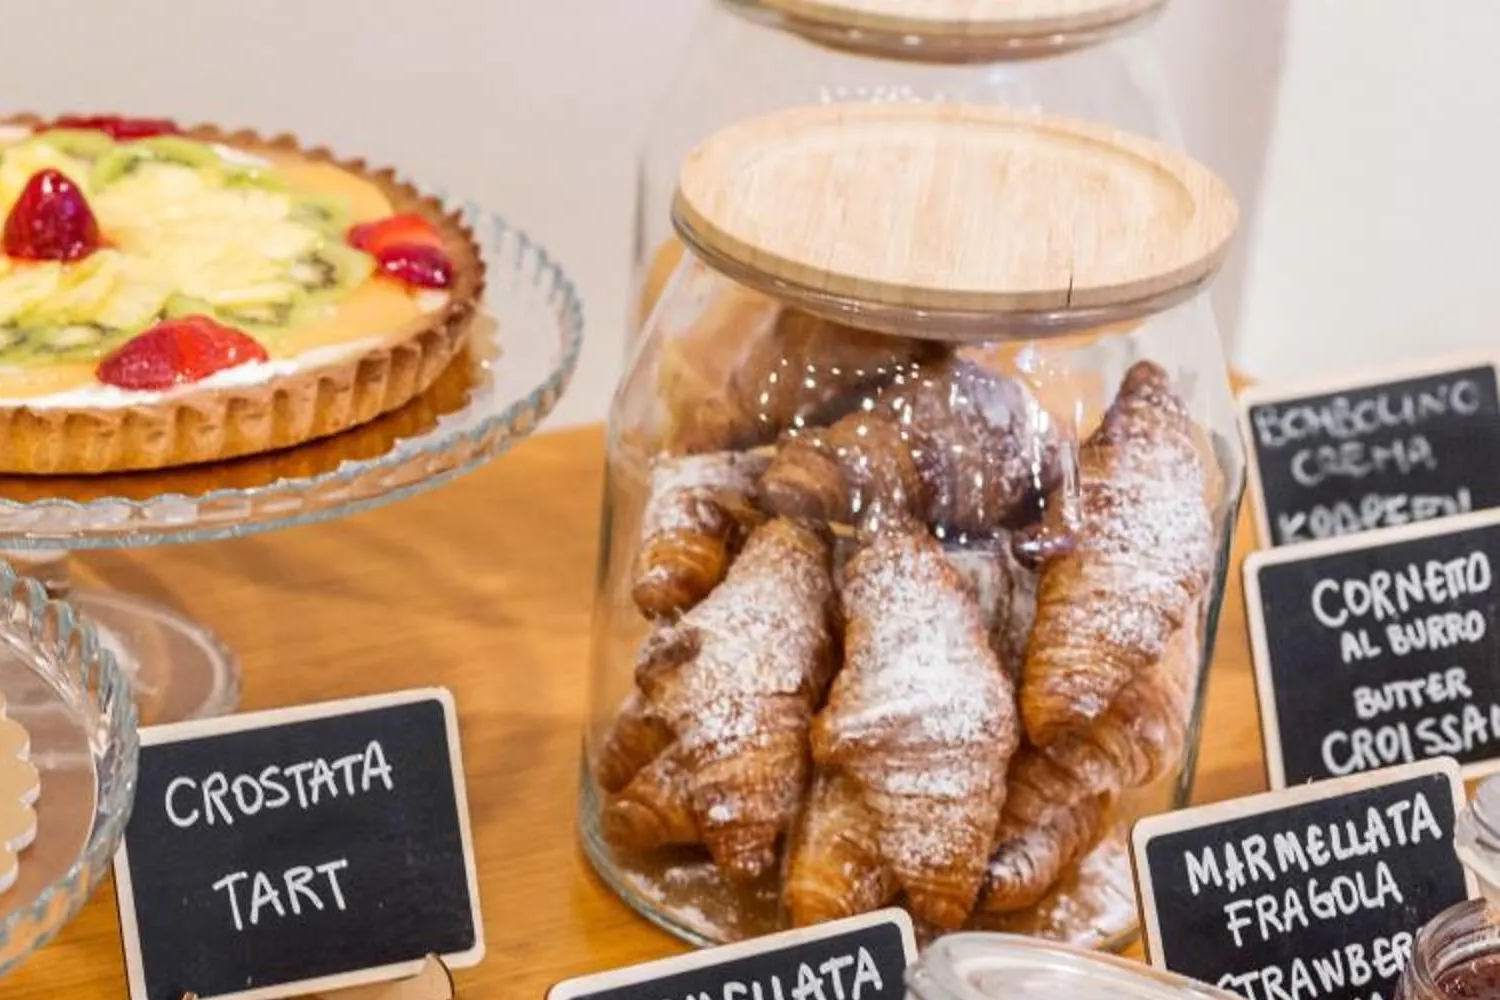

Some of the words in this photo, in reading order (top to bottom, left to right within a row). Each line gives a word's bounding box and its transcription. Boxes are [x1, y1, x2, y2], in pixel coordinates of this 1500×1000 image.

[1291, 435, 1438, 487] CREMA
[1312, 551, 1492, 628] CORNETTO
[1340, 630, 1381, 662] AL
[1386, 610, 1486, 655] BURRO
[1353, 667, 1473, 719] BUTTER
[164, 740, 394, 828] CROSTATA
[1184, 792, 1444, 895] MARMELLATA
[212, 859, 348, 931] TART
[1223, 861, 1404, 947] FRAGOLA
